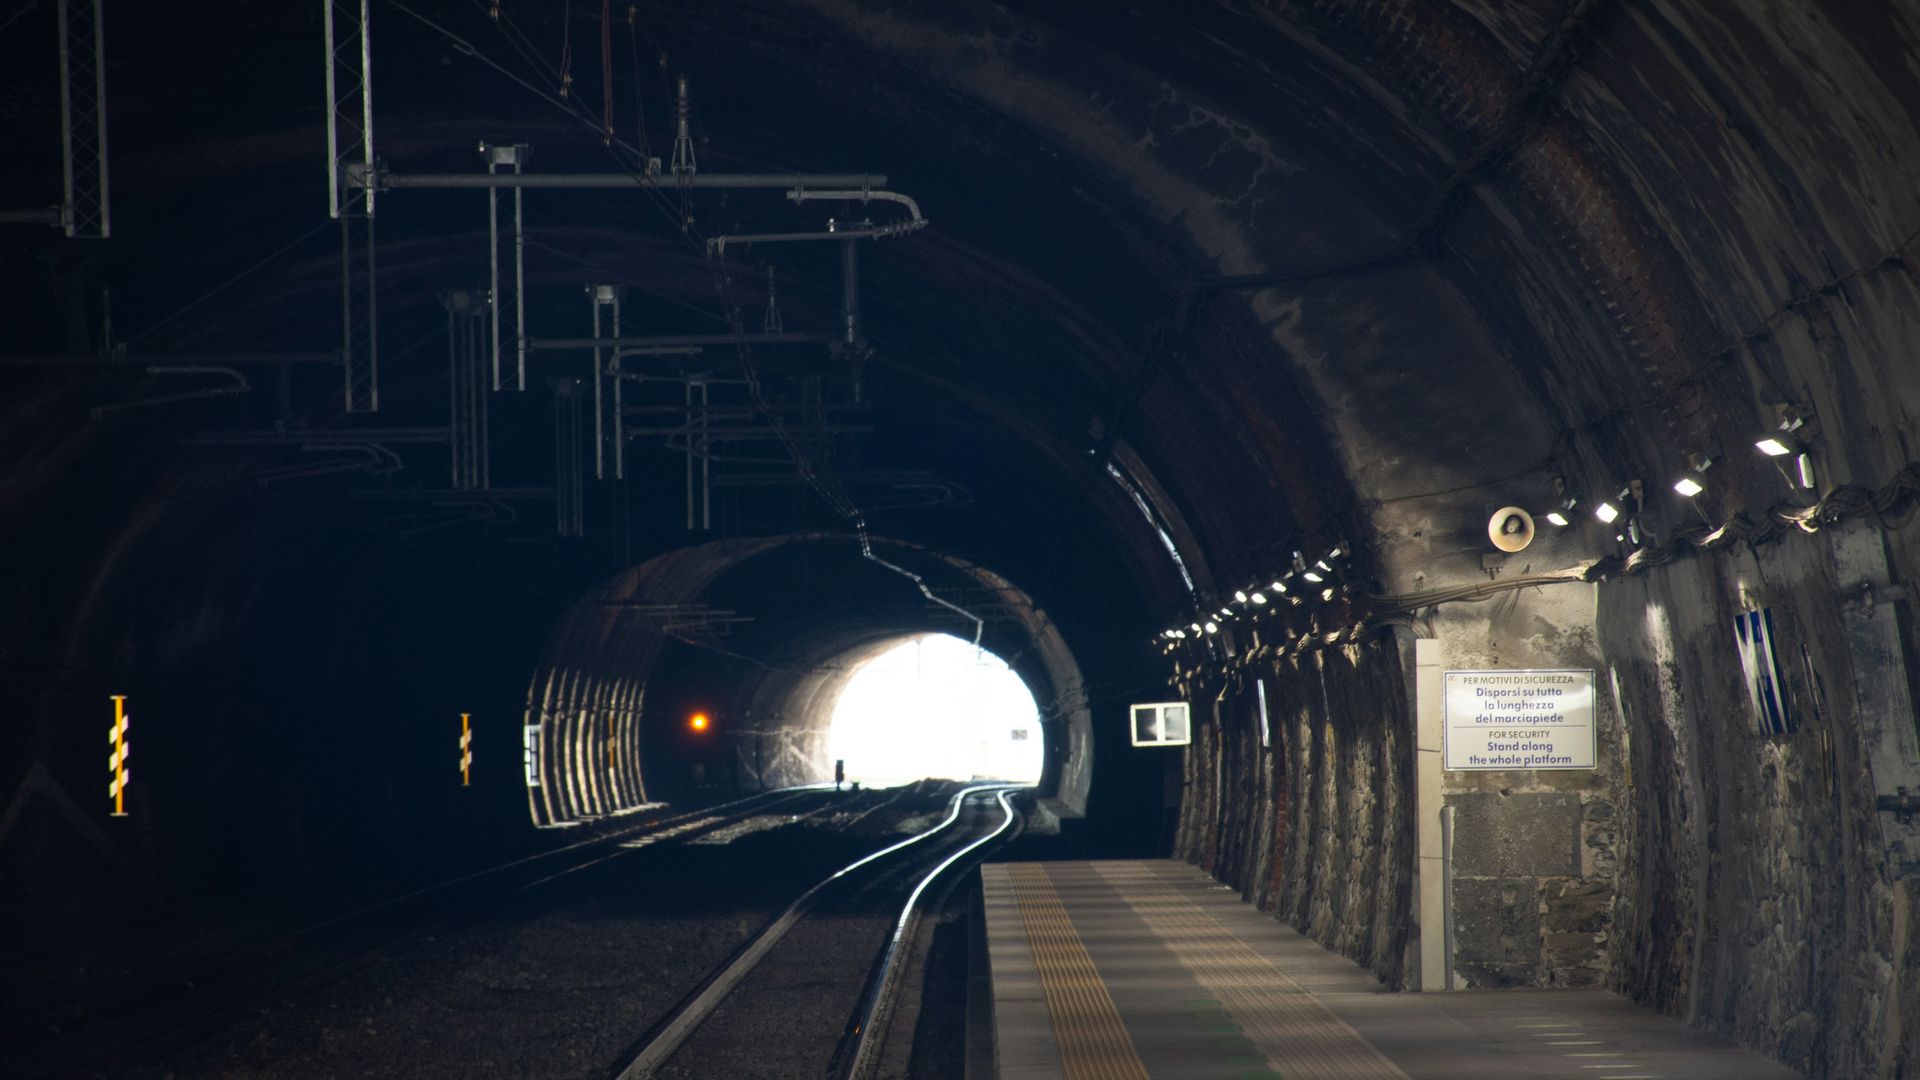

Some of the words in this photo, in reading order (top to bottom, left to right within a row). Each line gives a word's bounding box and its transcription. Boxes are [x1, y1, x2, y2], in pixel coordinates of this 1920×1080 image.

[1463, 676, 1479, 685] PER
[1480, 676, 1512, 685] MOTIVI
[1513, 676, 1523, 684] DI
[1525, 676, 1574, 684] SICUREZZA
[1476, 688, 1521, 699] Disporsi
[1523, 689, 1534, 697] su
[1536, 688, 1562, 696] tutta
[1484, 700, 1495, 710] la
[1497, 700, 1554, 712] lunghezza
[1475, 714, 1492, 723] del
[1495, 713, 1564, 725] marciapiede
[1489, 731, 1507, 739] FOR
[1508, 730, 1550, 738] SECURITY
[1488, 742, 1519, 751] Stand
[1521, 742, 1553, 752] along
[1469, 755, 1487, 764] the
[1489, 755, 1522, 764] whole
[1524, 754, 1572, 767] platform
